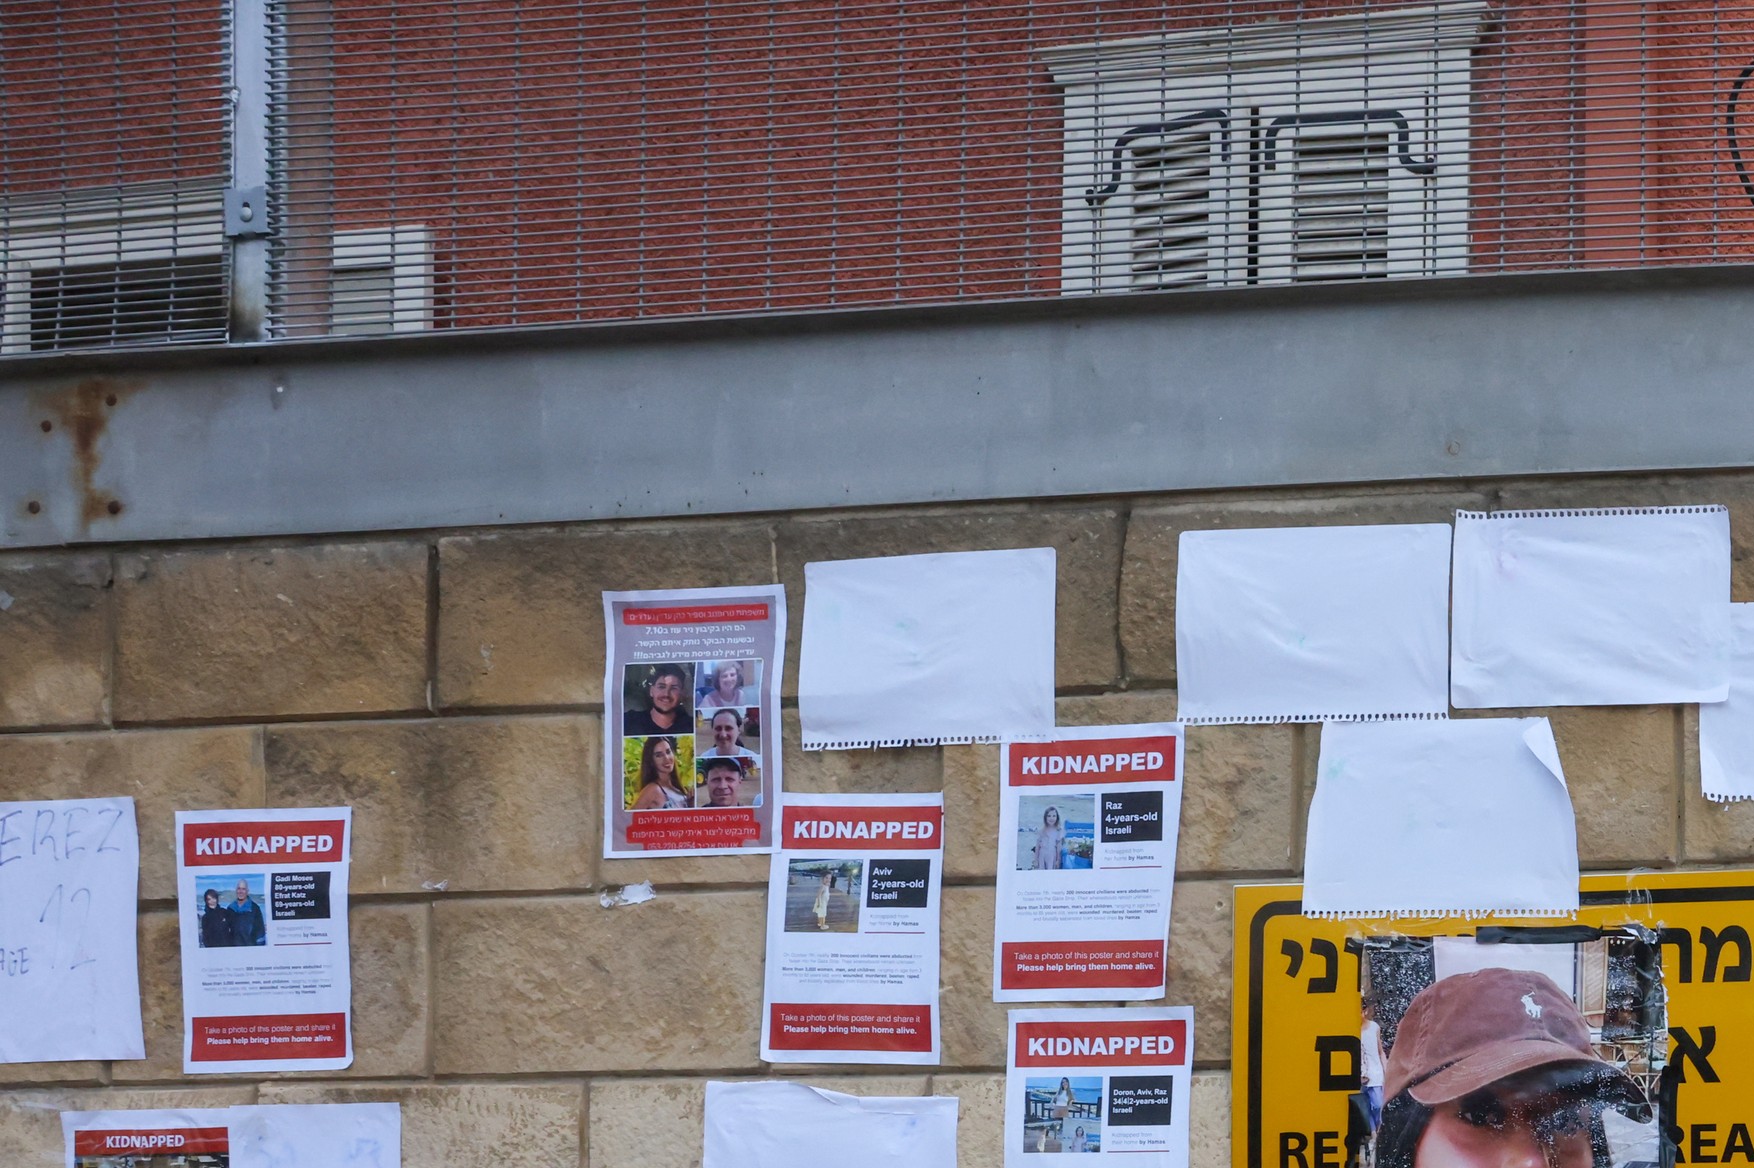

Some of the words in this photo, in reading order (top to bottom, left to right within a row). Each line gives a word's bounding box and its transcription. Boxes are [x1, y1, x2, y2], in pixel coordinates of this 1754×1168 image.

[1022, 752, 1164, 775] KIDNAPPED
[1106, 812, 1157, 824] 4-years-old
[0, 807, 123, 866] EREZ
[793, 821, 934, 839] KIDNAPPED
[1106, 825, 1131, 834] Israeli
[195, 835, 334, 856] KIDNAPPED
[1028, 1036, 1175, 1056] KIDNAPPED
[106, 1135, 185, 1149] KIDNAPPED
